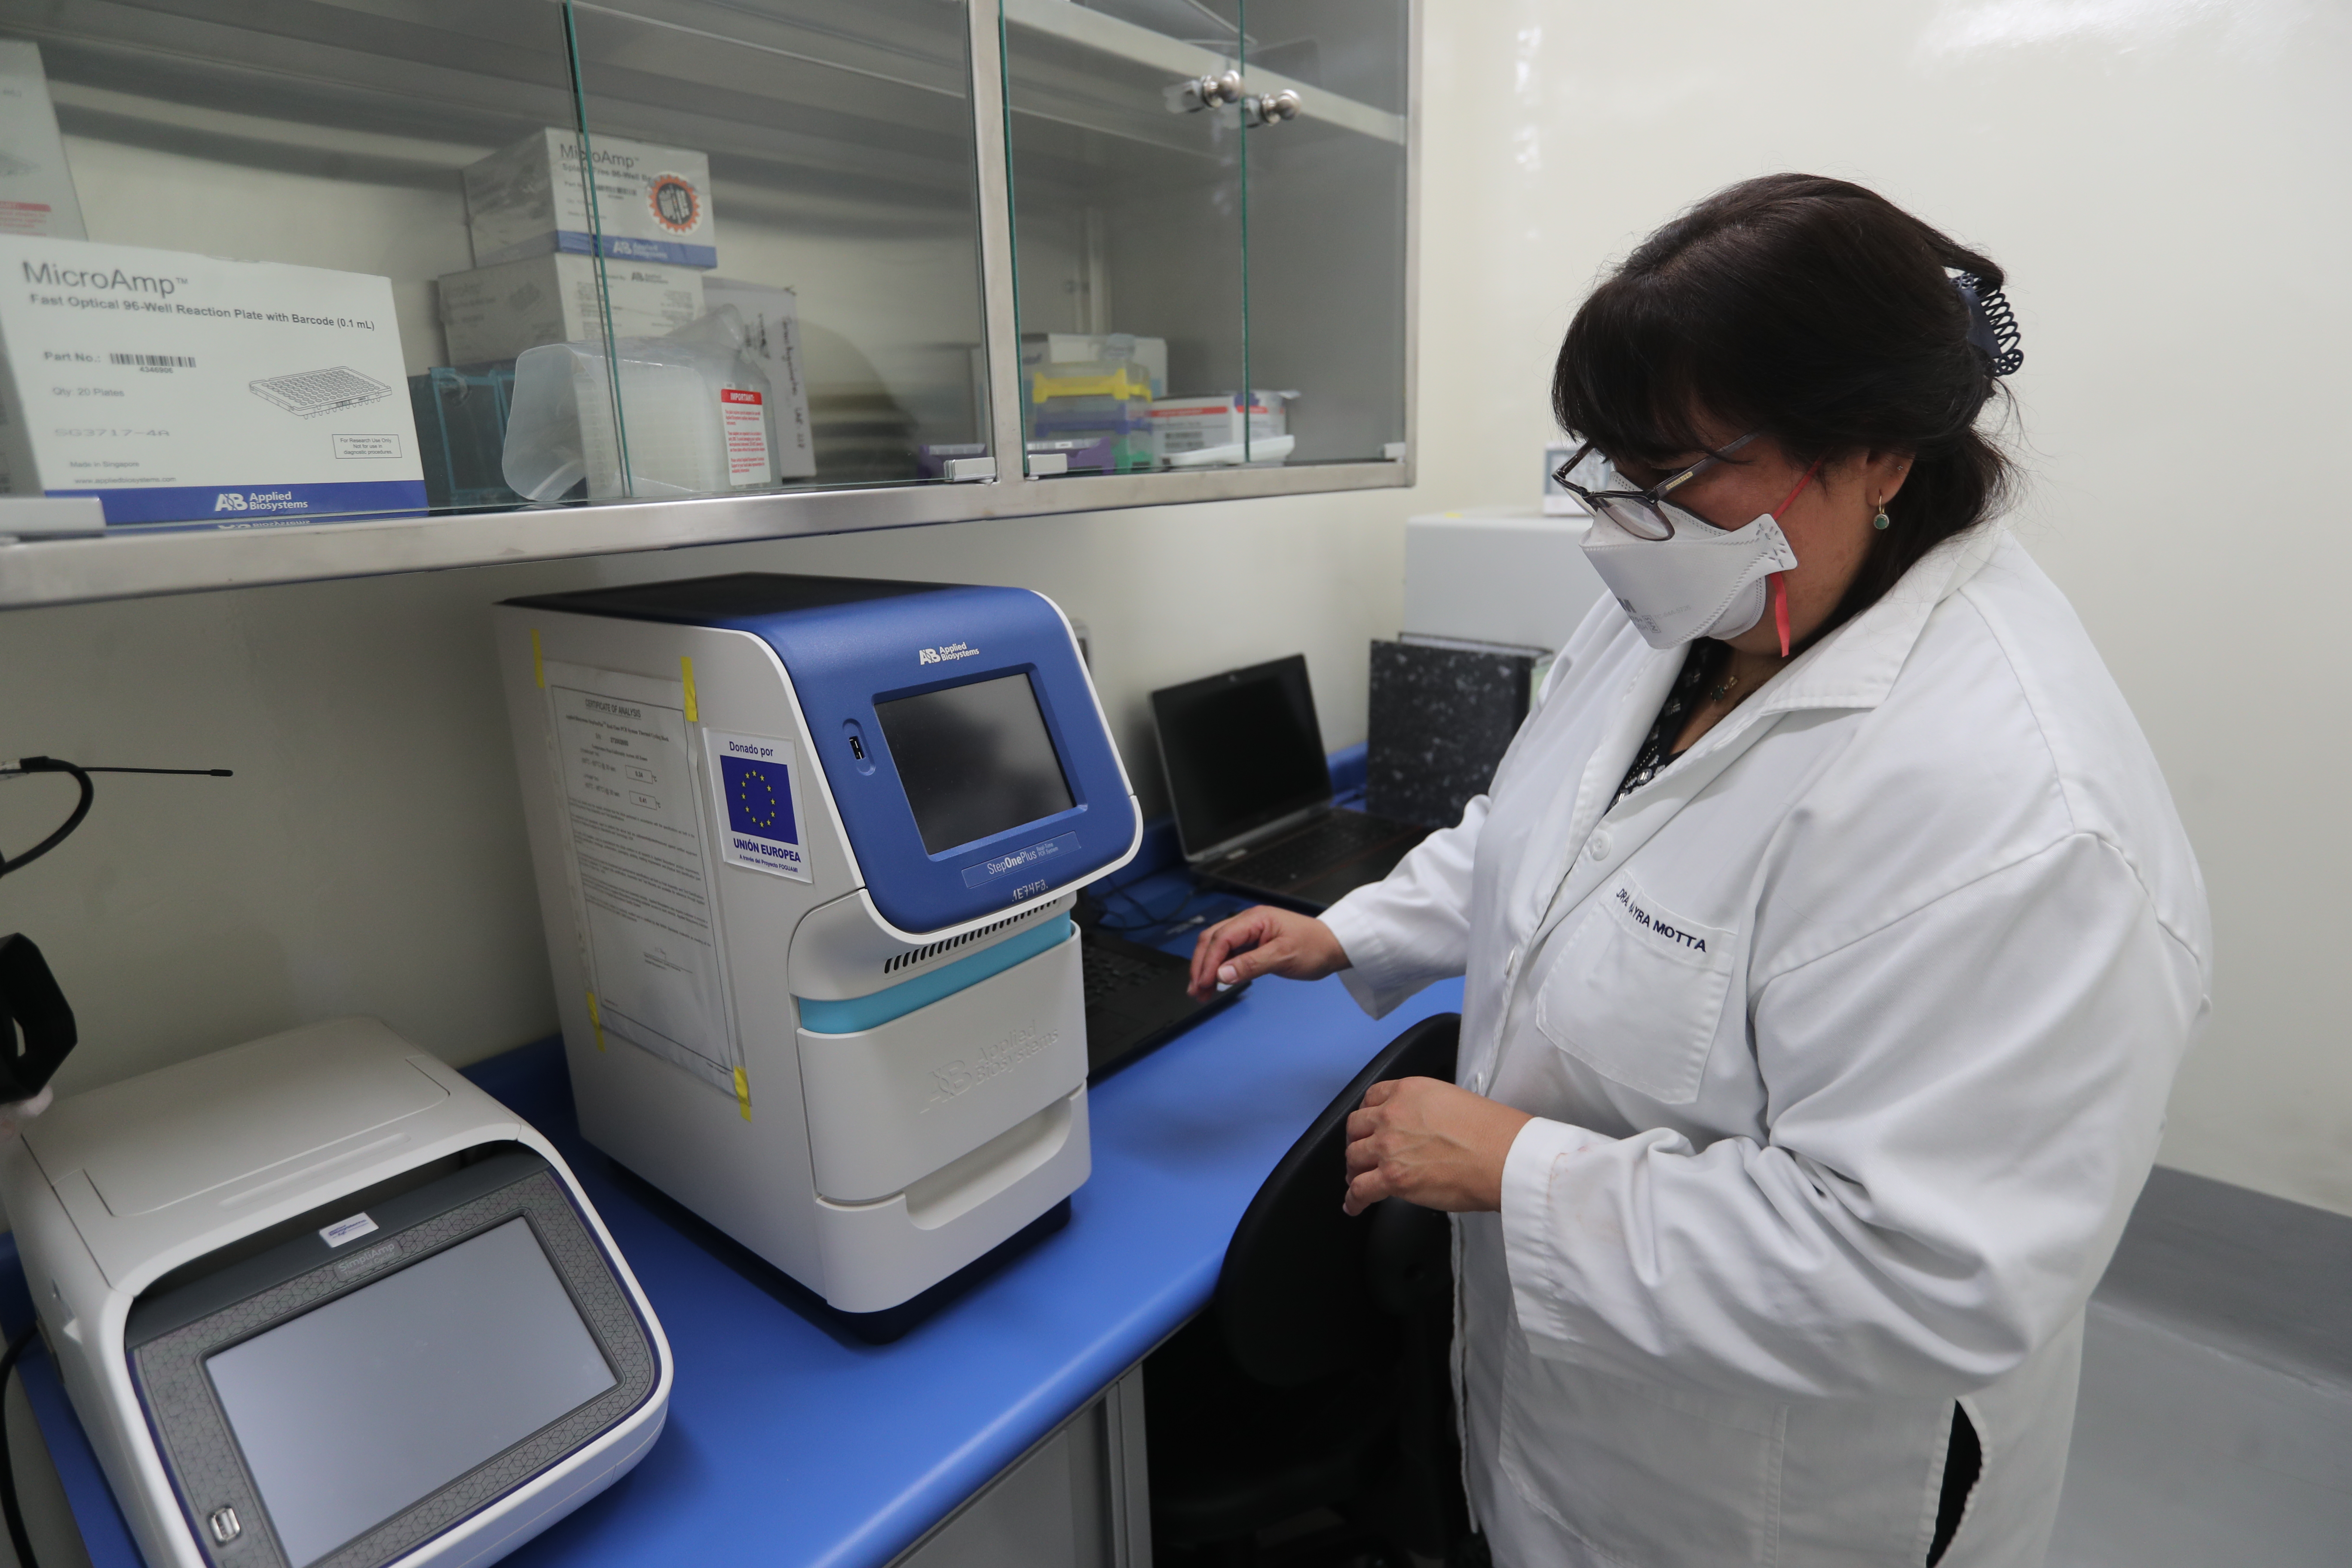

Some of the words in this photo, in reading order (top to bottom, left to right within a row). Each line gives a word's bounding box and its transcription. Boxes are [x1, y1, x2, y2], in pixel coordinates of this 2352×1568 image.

[30, 294, 63, 306] Fast
[68, 296, 119, 309] Optical
[124, 301, 172, 313] 96-Well
[176, 304, 231, 317] Reaction
[235, 309, 263, 320] Plate
[266, 312, 289, 322] with
[292, 314, 334, 326] Barcode
[337, 318, 354, 329] (0.1
[357, 321, 375, 331] mL)
[44, 352, 72, 361] Part
[93, 388, 125, 397] Plates
[249, 491, 292, 502] Applied
[249, 501, 308, 511] Biosystems
[939, 642, 967, 654] Applied
[941, 649, 980, 661] Biosystems
[585, 699, 610, 712] CERTIFICATE
[619, 707, 641, 718] ANALYSIS
[729, 741, 758, 754] Donado
[761, 747, 773, 757] por
[733, 838, 760, 853] UNIÓN
[760, 843, 802, 863] EUROPEA
[1036, 842, 1054, 851] Real-Time
[761, 860, 778, 868] Proyecto
[987, 851, 1037, 875] StepOnePlus
[1653, 920, 1706, 952] MOTTA
[977, 1020, 1035, 1064] Applied
[975, 1029, 1058, 1085] Biosystems
[339, 1244, 395, 1271] SimpliAmp
[345, 1262, 374, 1275] Thermal
[374, 1251, 395, 1265] Cycler
